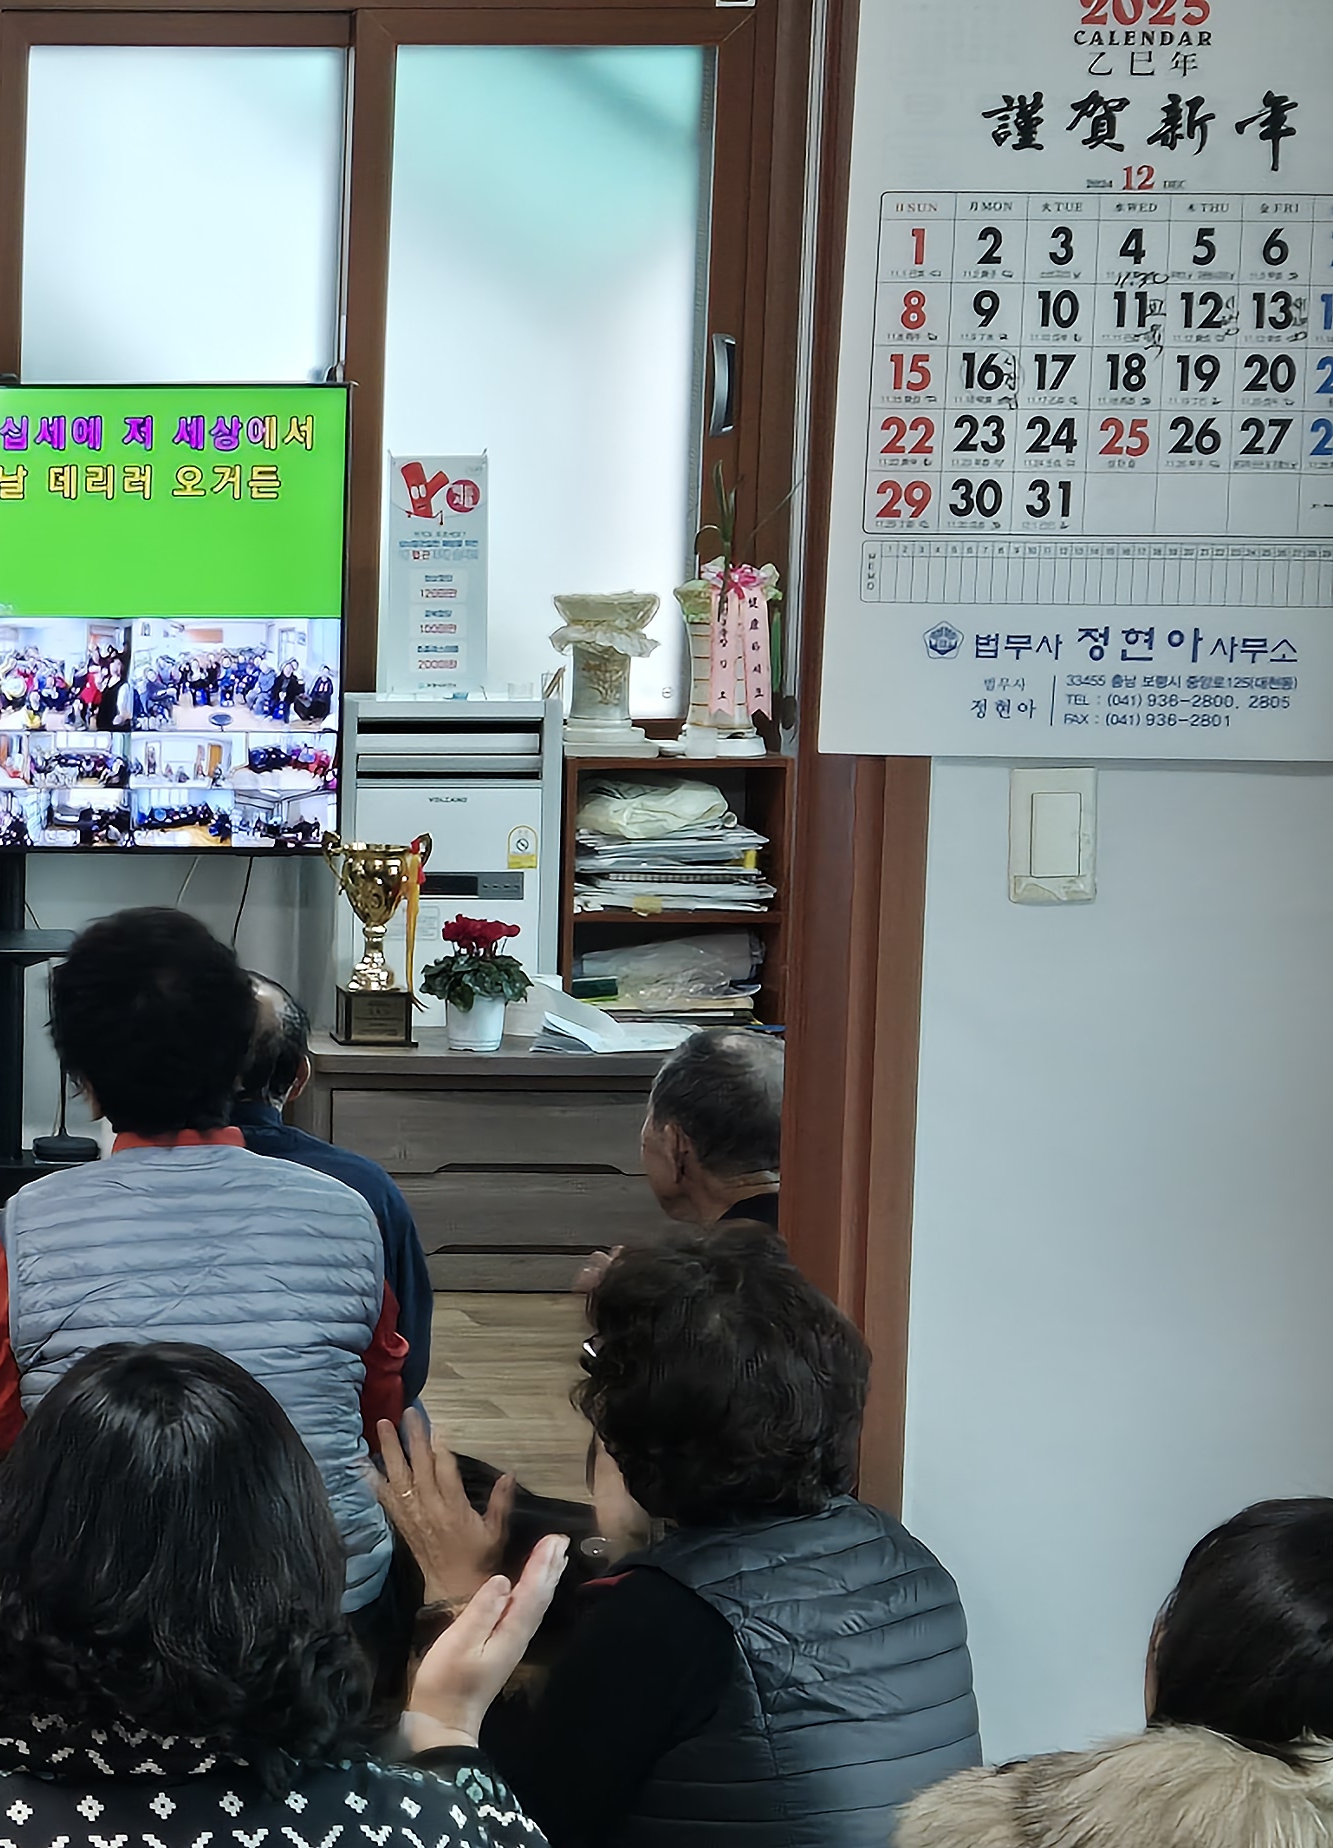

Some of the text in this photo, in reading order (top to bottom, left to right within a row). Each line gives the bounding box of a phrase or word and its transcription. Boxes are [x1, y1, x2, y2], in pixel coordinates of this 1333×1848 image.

[1079, 0, 1211, 26] 2025
[1073, 30, 1213, 46] CALENDAR
[981, 90, 1299, 172] 謹賀新年
[1121, 165, 1155, 190] 12
[907, 202, 939, 213] SUN
[981, 201, 1013, 212] MON
[1055, 202, 1083, 213] TUE
[1127, 202, 1158, 213] WED
[1200, 202, 1230, 213] THU
[1272, 202, 1300, 213] FRI
[911, 228, 925, 265] 1
[977, 226, 1003, 265] 2
[1049, 226, 1074, 266] 3
[1119, 227, 1146, 265] 4
[1192, 227, 1217, 266] 5
[1262, 227, 1289, 266] 6
[900, 290, 926, 330] 8
[973, 290, 1000, 328] 9
[1037, 290, 1080, 329] 10
[1113, 291, 1148, 328] 11
[1181, 291, 1223, 329] 12
[1252, 291, 1293, 330] 13
[890, 353, 931, 391] 15
[962, 352, 1004, 391] 16
[1034, 353, 1076, 391] 17
[1107, 353, 1146, 392] 18
[1177, 354, 1221, 393] 19
[1243, 353, 1296, 393] 20
[121, 415, 155, 452] 저
[173, 414, 315, 452] 세상에서
[880, 416, 934, 454] 22
[953, 415, 1006, 454] 23
[1025, 416, 1077, 454] 24
[1099, 417, 1150, 457] 25
[1168, 416, 1222, 455] 26
[1240, 417, 1294, 455] 27
[47, 464, 153, 500] 데리러
[171, 464, 283, 500] 오거든
[876, 479, 932, 518] 29
[949, 478, 1003, 518] 30
[1026, 479, 1071, 518] 31
[975, 625, 1298, 664] 법무사 정현아 사무소
[970, 697, 1037, 720] 정현아
[1064, 713, 1090, 725] FAX
[1105, 712, 1141, 727] (041)
[1146, 713, 1231, 728] 936-2801
[1066, 694, 1091, 707] TEL
[1107, 693, 1142, 709] (041)
[1248, 695, 1291, 710] 2805
